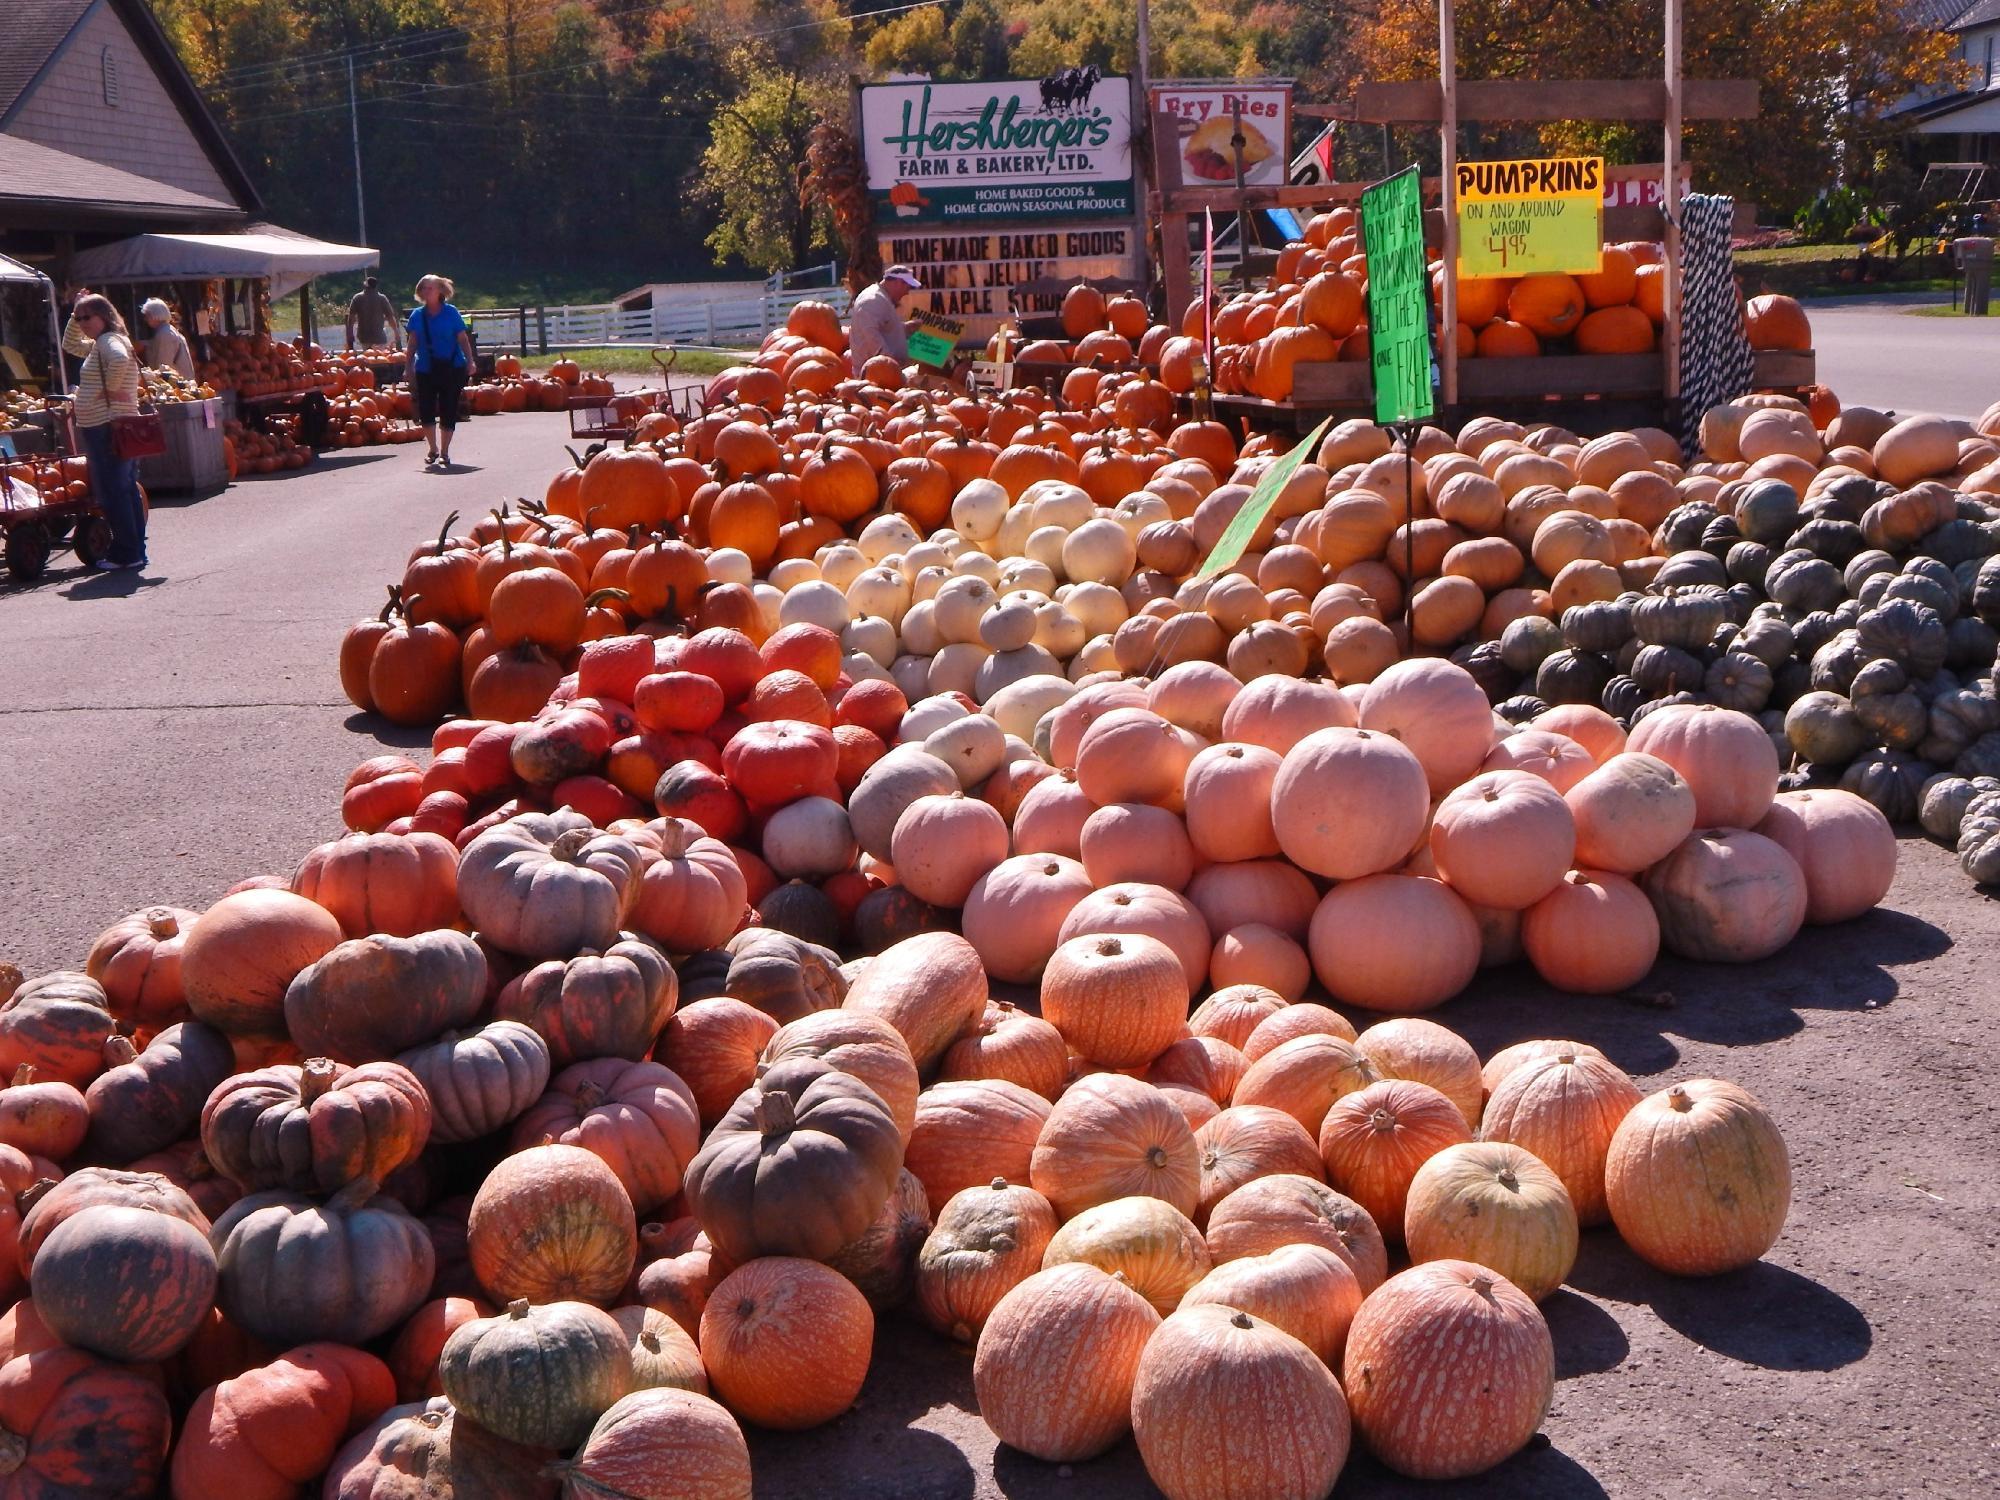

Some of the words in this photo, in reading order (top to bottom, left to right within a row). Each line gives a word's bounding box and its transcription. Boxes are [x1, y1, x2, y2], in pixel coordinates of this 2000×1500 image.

[1165, 97, 1213, 122] Fry
[1222, 94, 1278, 117] Pies
[883, 85, 1112, 162] Hershberger's
[899, 157, 949, 176] FARM
[956, 157, 969, 174] &
[1058, 153, 1094, 170] LTD.
[1457, 160, 1599, 196] PUMPKINS
[944, 203, 976, 214] HOME
[979, 201, 1020, 213] GROWN
[1023, 200, 1073, 211] SEASONAL
[1077, 198, 1126, 209] PRODUCE
[975, 189, 1007, 200] HOME
[1010, 188, 1042, 199] BAKED
[1045, 187, 1084, 198] GOODS
[1087, 186, 1095, 197] &
[1467, 204, 1483, 219] ON
[1490, 202, 1515, 219] AND
[1491, 219, 1530, 236] WAGON
[893, 236, 989, 263] HOMEMADE
[1000, 234, 1058, 260] BAKED
[1067, 230, 1125, 256] GOODS
[1374, 241, 1425, 291] PUMPKINS
[930, 289, 992, 315] MAPLE
[910, 306, 964, 335] PUMPKINS
[1377, 347, 1391, 368] ONE
[1396, 333, 1431, 410] FREE
